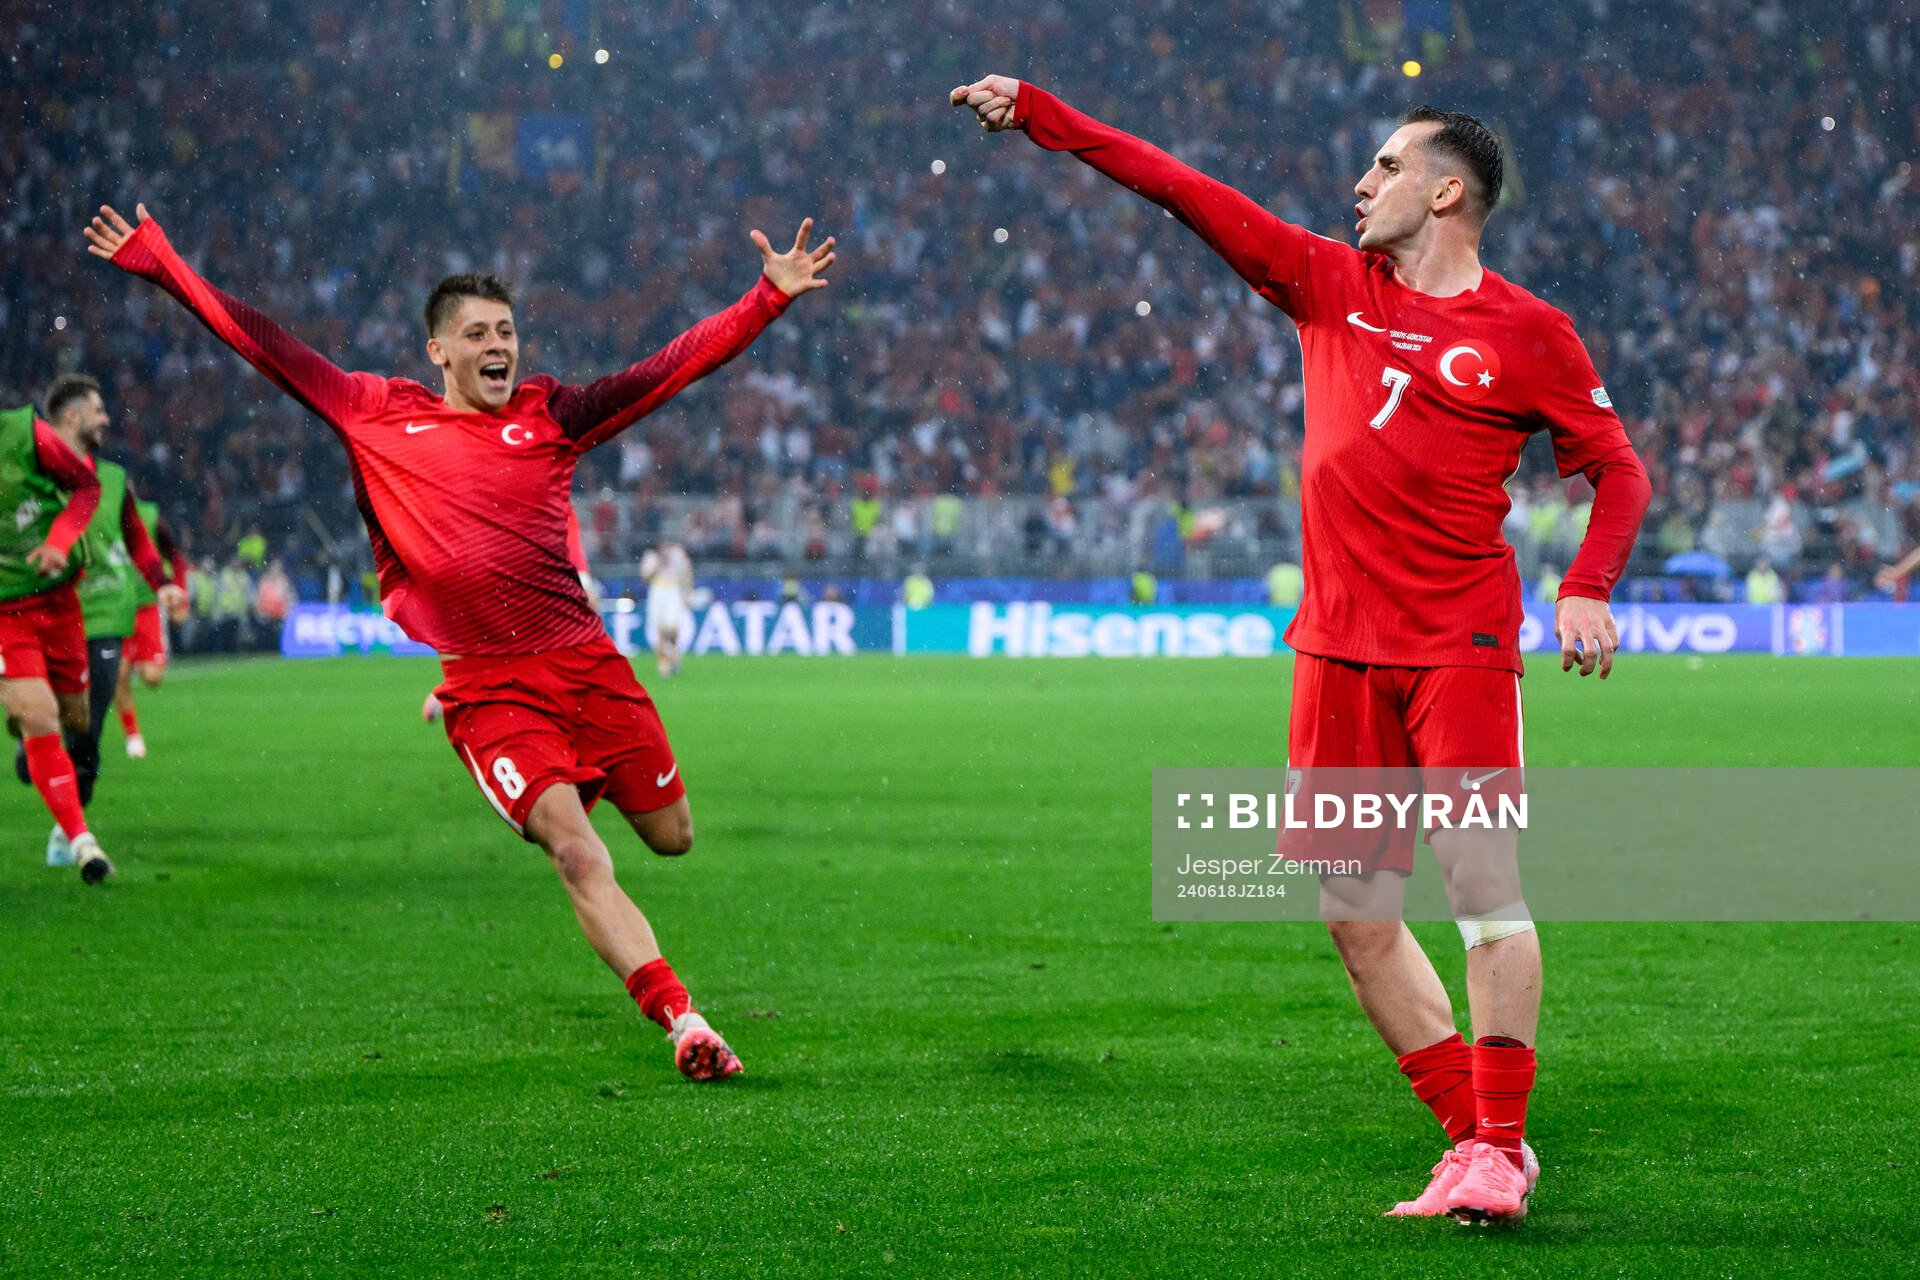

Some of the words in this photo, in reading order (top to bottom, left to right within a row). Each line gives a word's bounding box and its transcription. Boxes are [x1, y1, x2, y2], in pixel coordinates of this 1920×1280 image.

[1370, 366, 1412, 430] 7
[969, 601, 1275, 658] Hisense
[492, 756, 527, 800] 8
